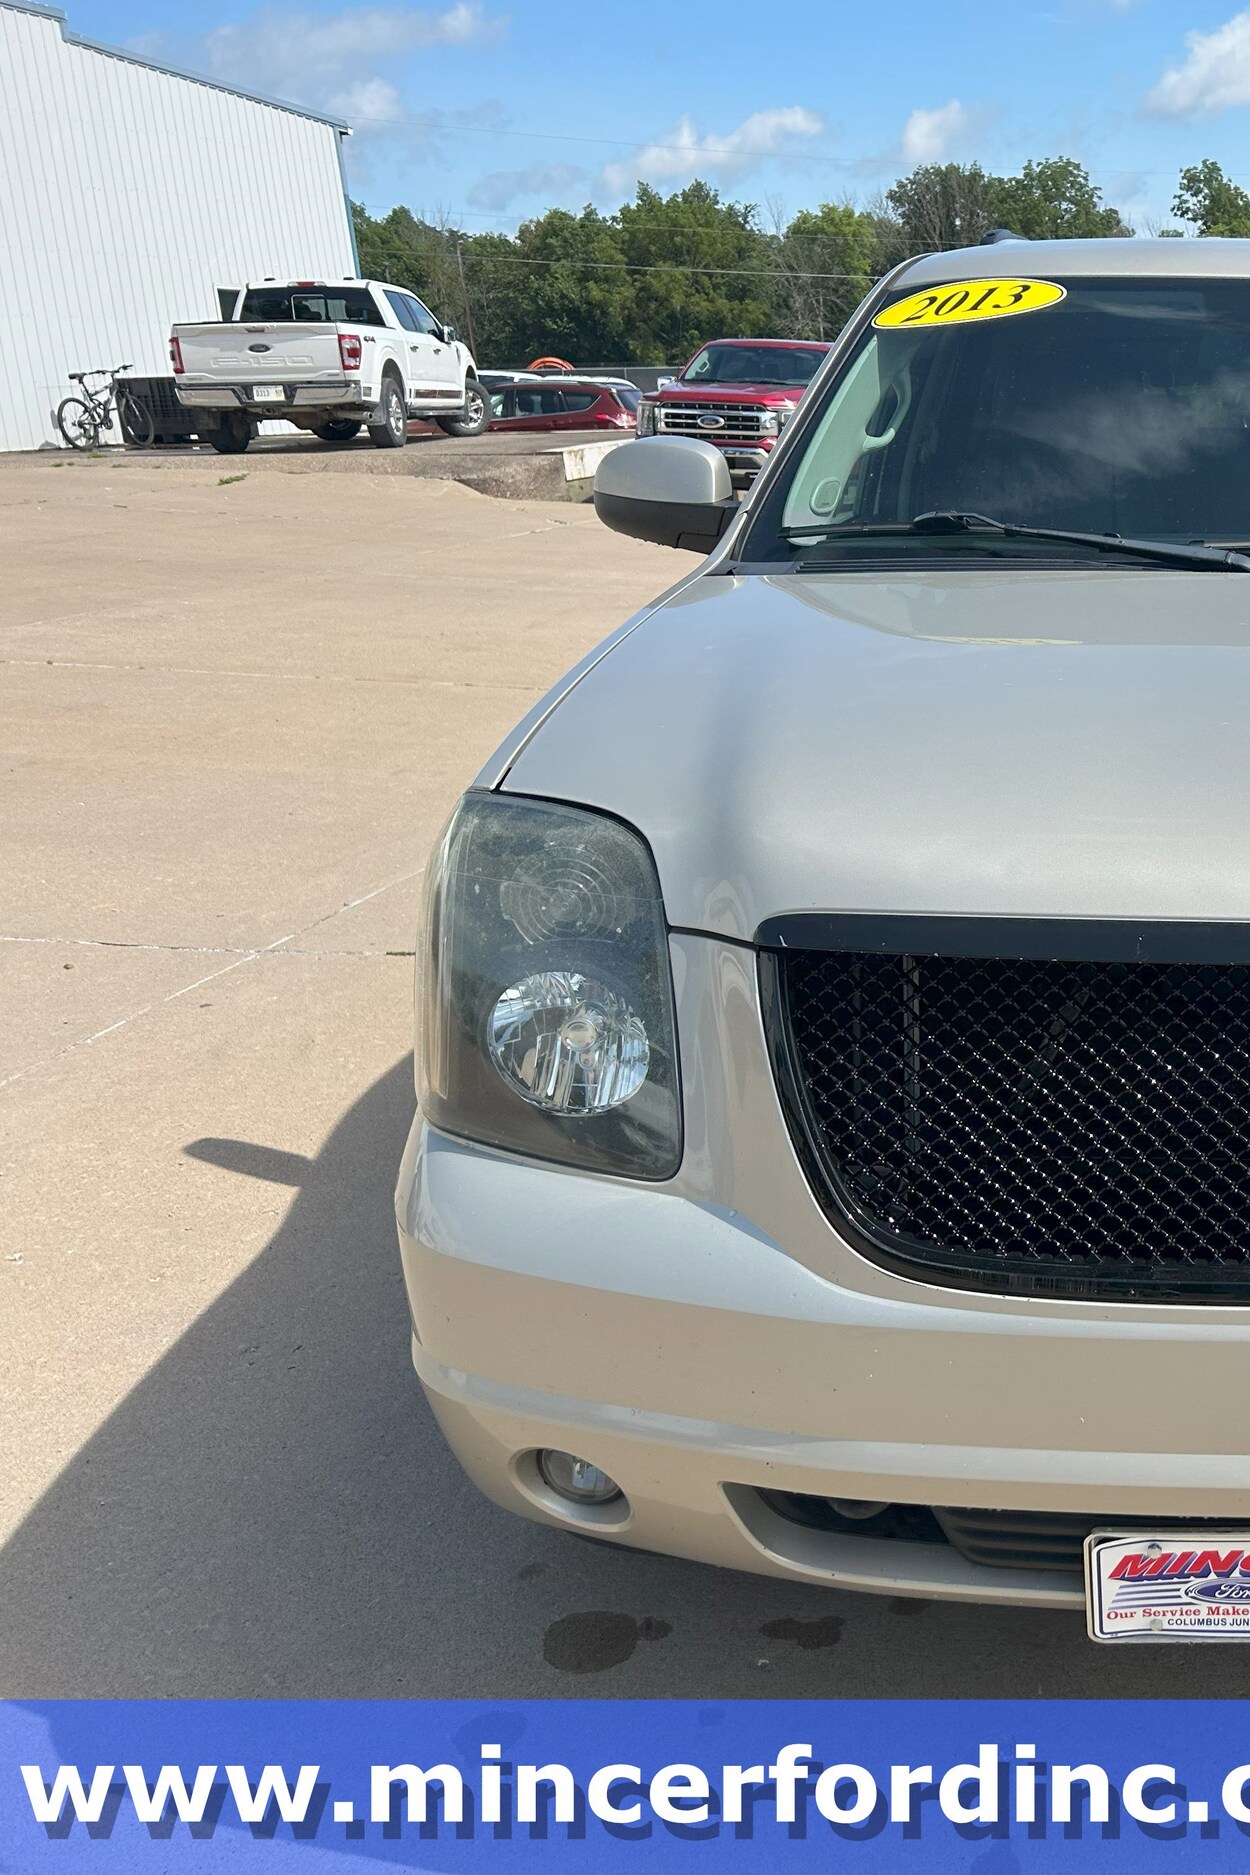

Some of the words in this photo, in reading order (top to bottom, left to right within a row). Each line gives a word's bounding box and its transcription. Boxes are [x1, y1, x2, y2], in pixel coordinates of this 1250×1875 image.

[900, 284, 1031, 323] 2013
[1106, 1610, 1137, 1620] Our
[1142, 1608, 1201, 1618] Service
[1167, 1618, 1227, 1627] COLUMBUS
